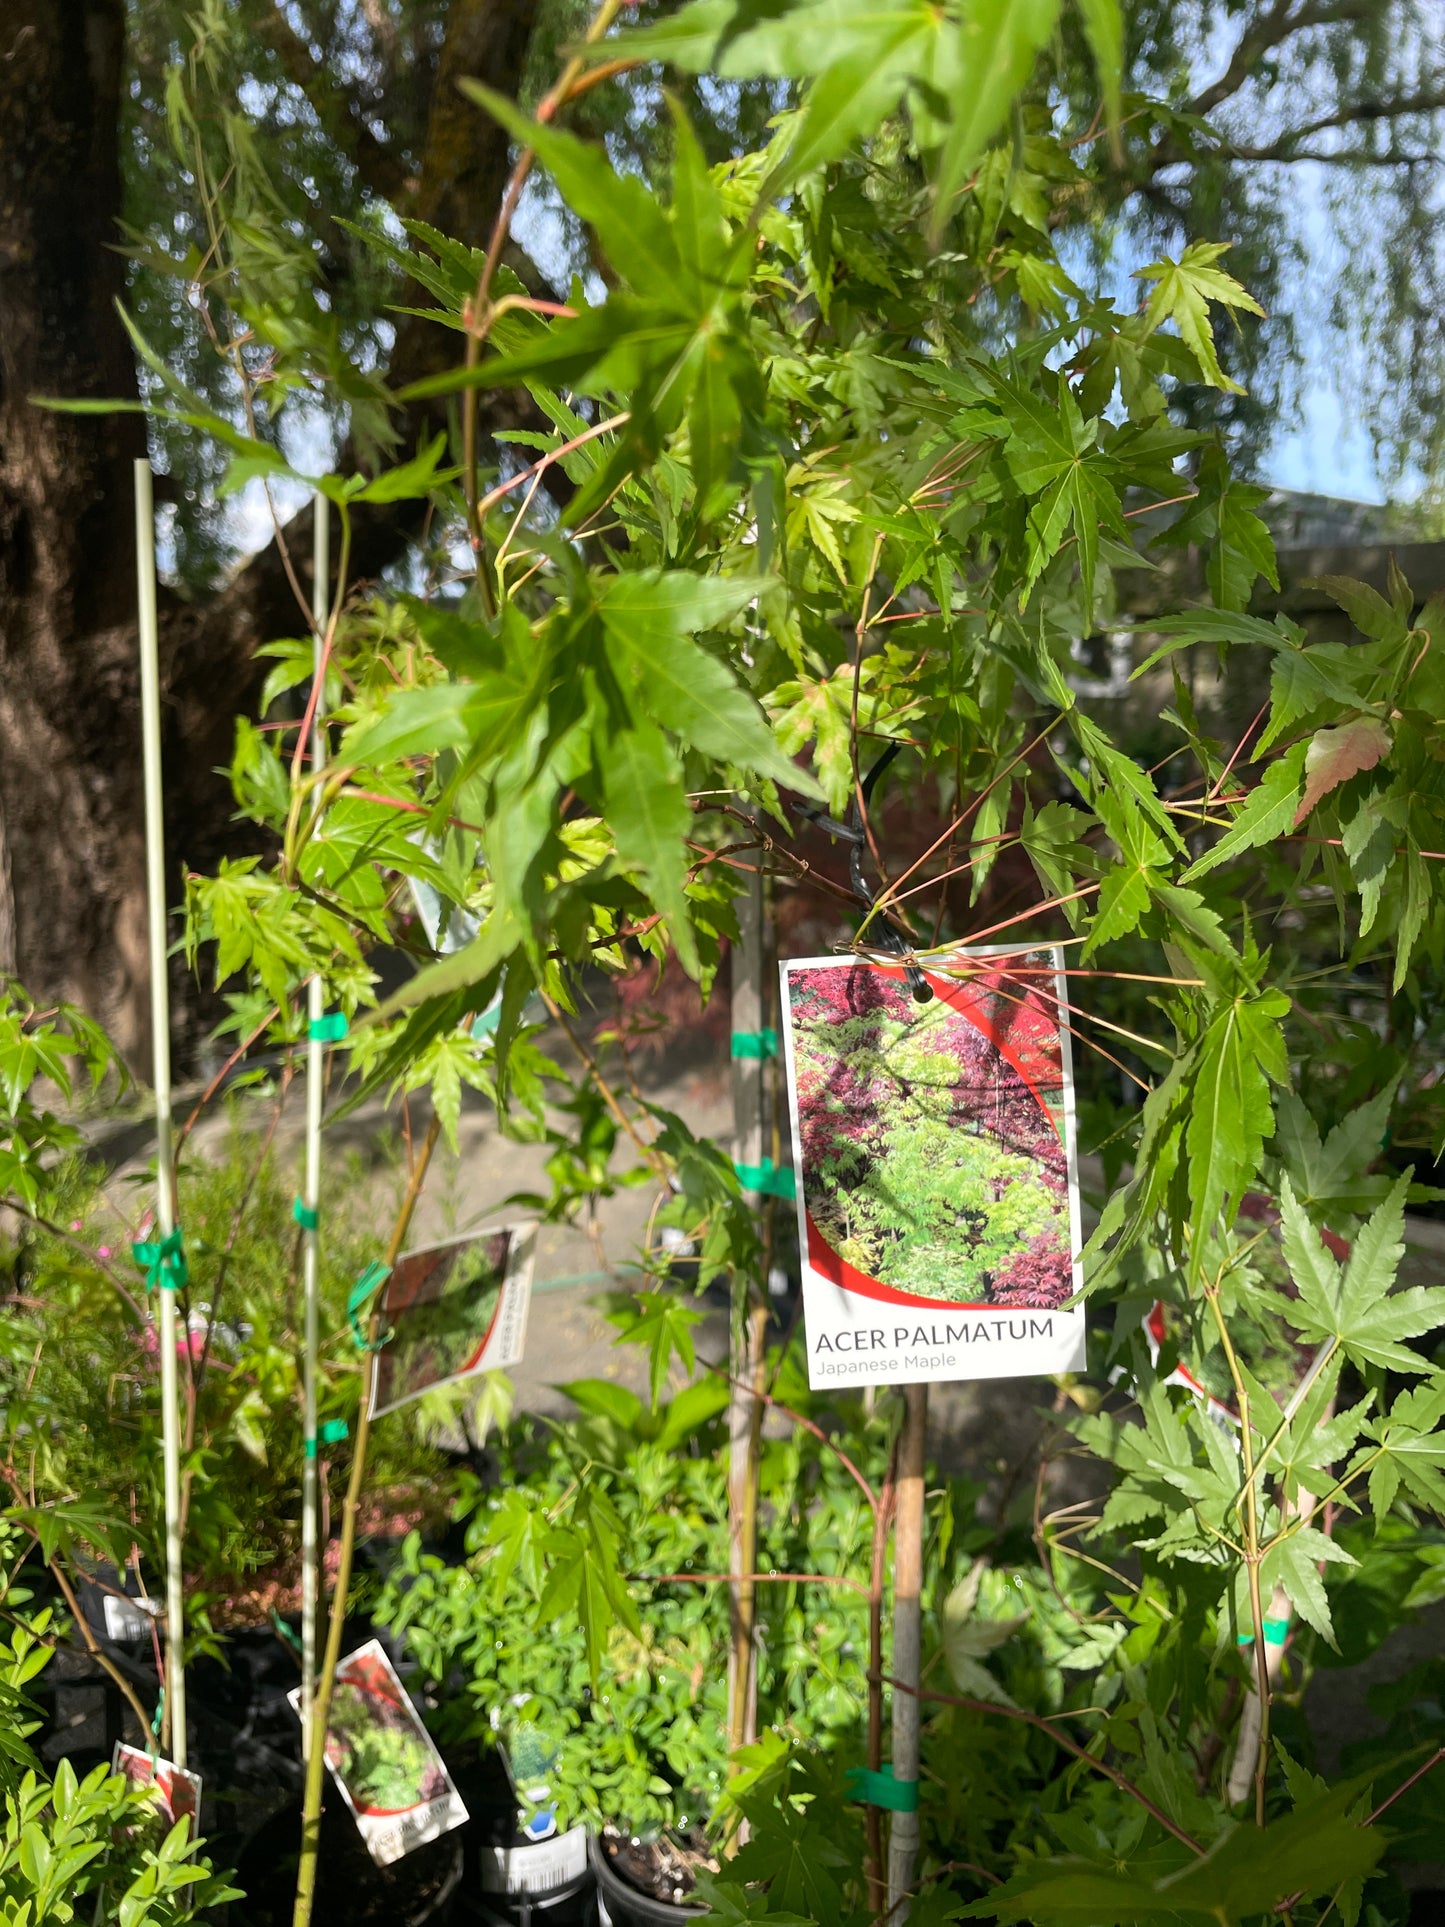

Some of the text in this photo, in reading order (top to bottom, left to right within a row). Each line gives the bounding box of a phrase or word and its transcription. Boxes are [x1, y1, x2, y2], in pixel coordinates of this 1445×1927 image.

[815, 1318, 1054, 1354] ACER PALMATUM
[816, 1353, 956, 1376] Japanese Maple
